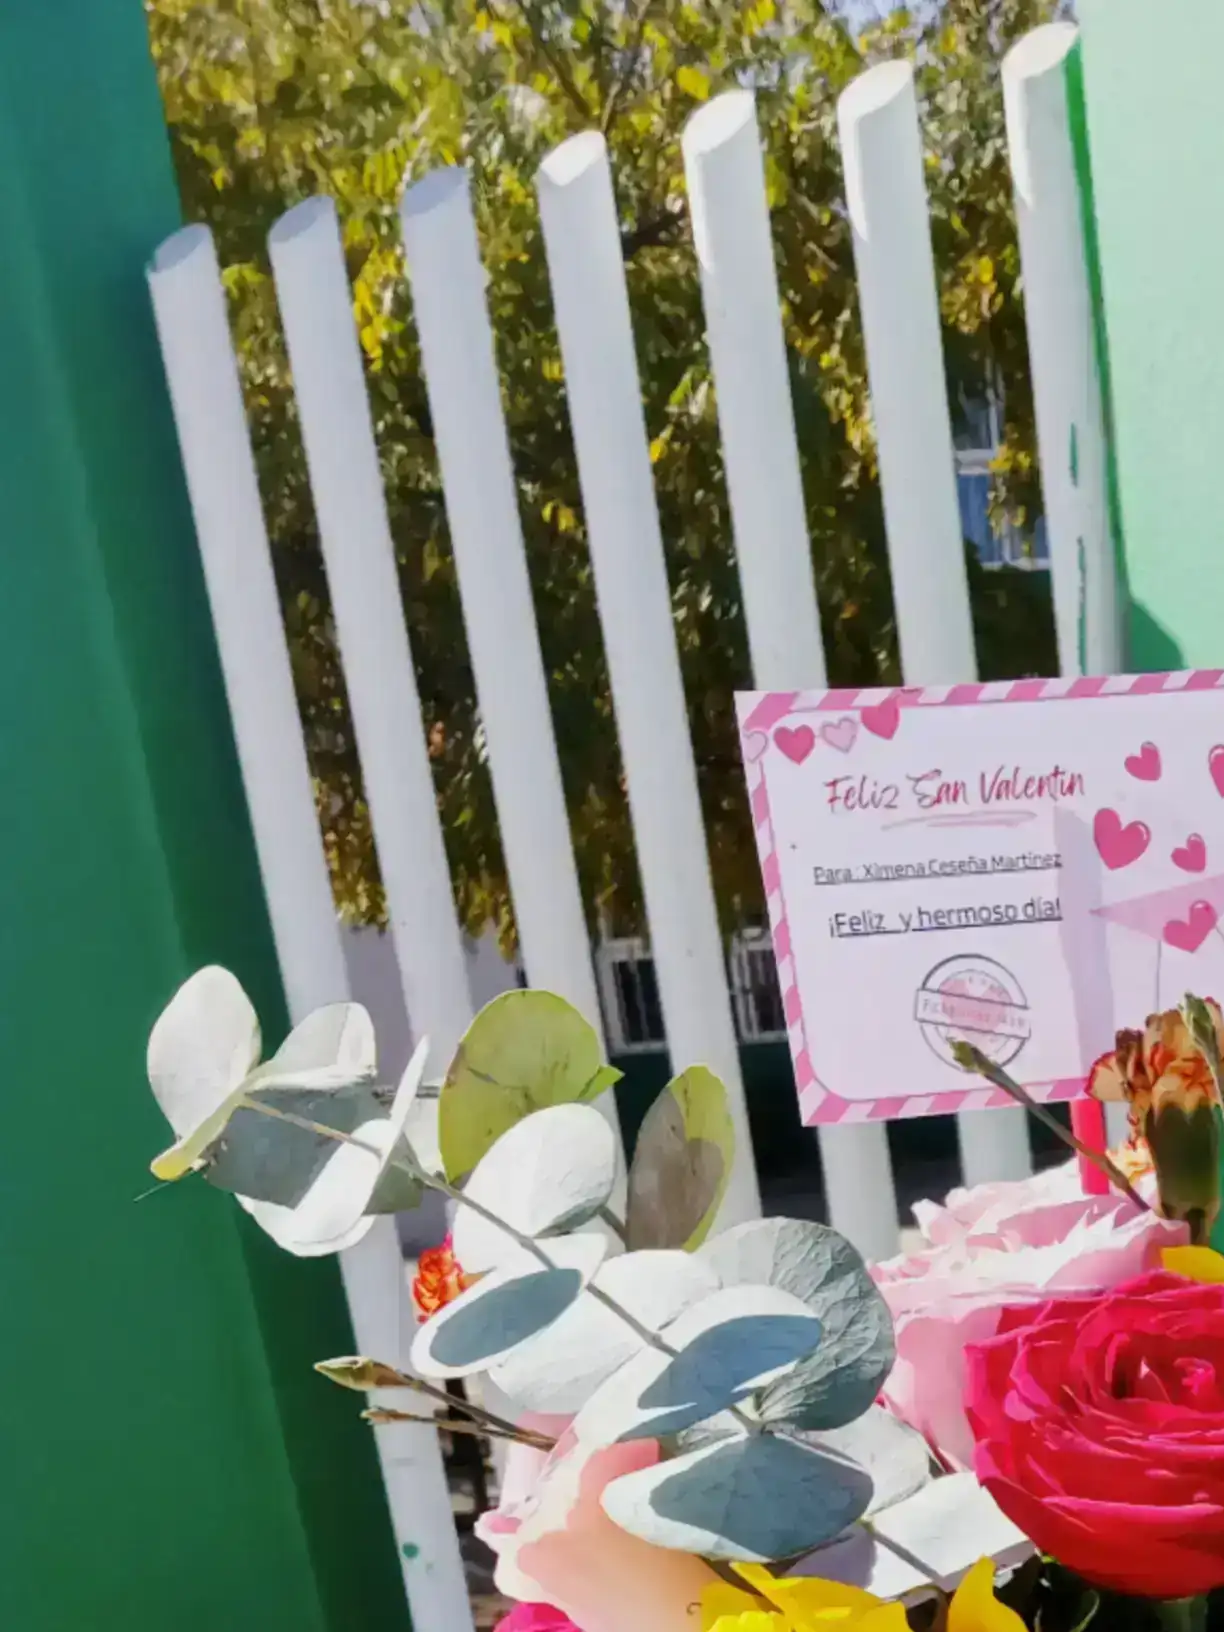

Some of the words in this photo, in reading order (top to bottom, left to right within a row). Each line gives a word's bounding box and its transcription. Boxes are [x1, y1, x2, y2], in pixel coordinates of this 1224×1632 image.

[823, 774, 899, 813] Feliz
[906, 768, 970, 809] San
[917, 905, 1019, 928] hermoso
